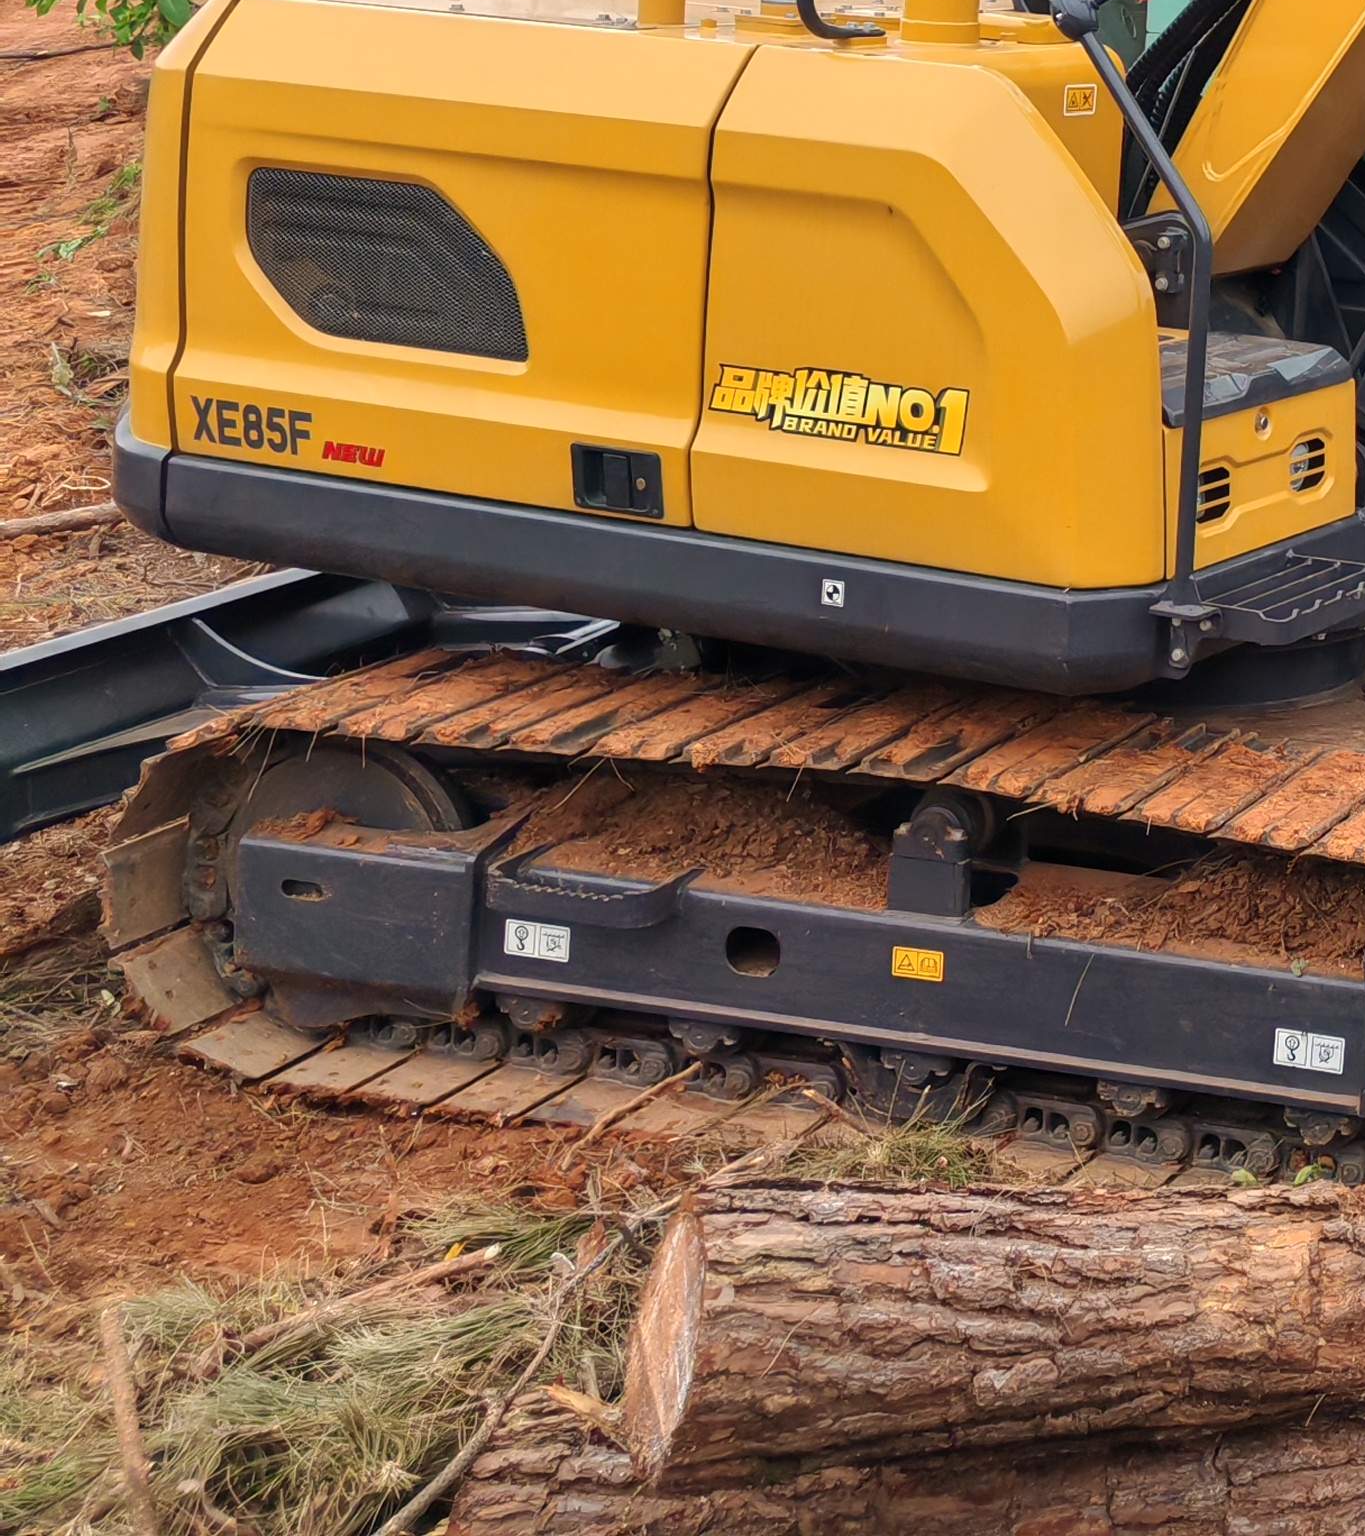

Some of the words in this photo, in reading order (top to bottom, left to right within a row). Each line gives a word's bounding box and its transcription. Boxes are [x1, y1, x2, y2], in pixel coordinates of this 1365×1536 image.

[191, 395, 312, 455] XE85F
[322, 441, 385, 467] NEW
[783, 416, 858, 440] BRAND
[866, 426, 938, 450] VALUE
